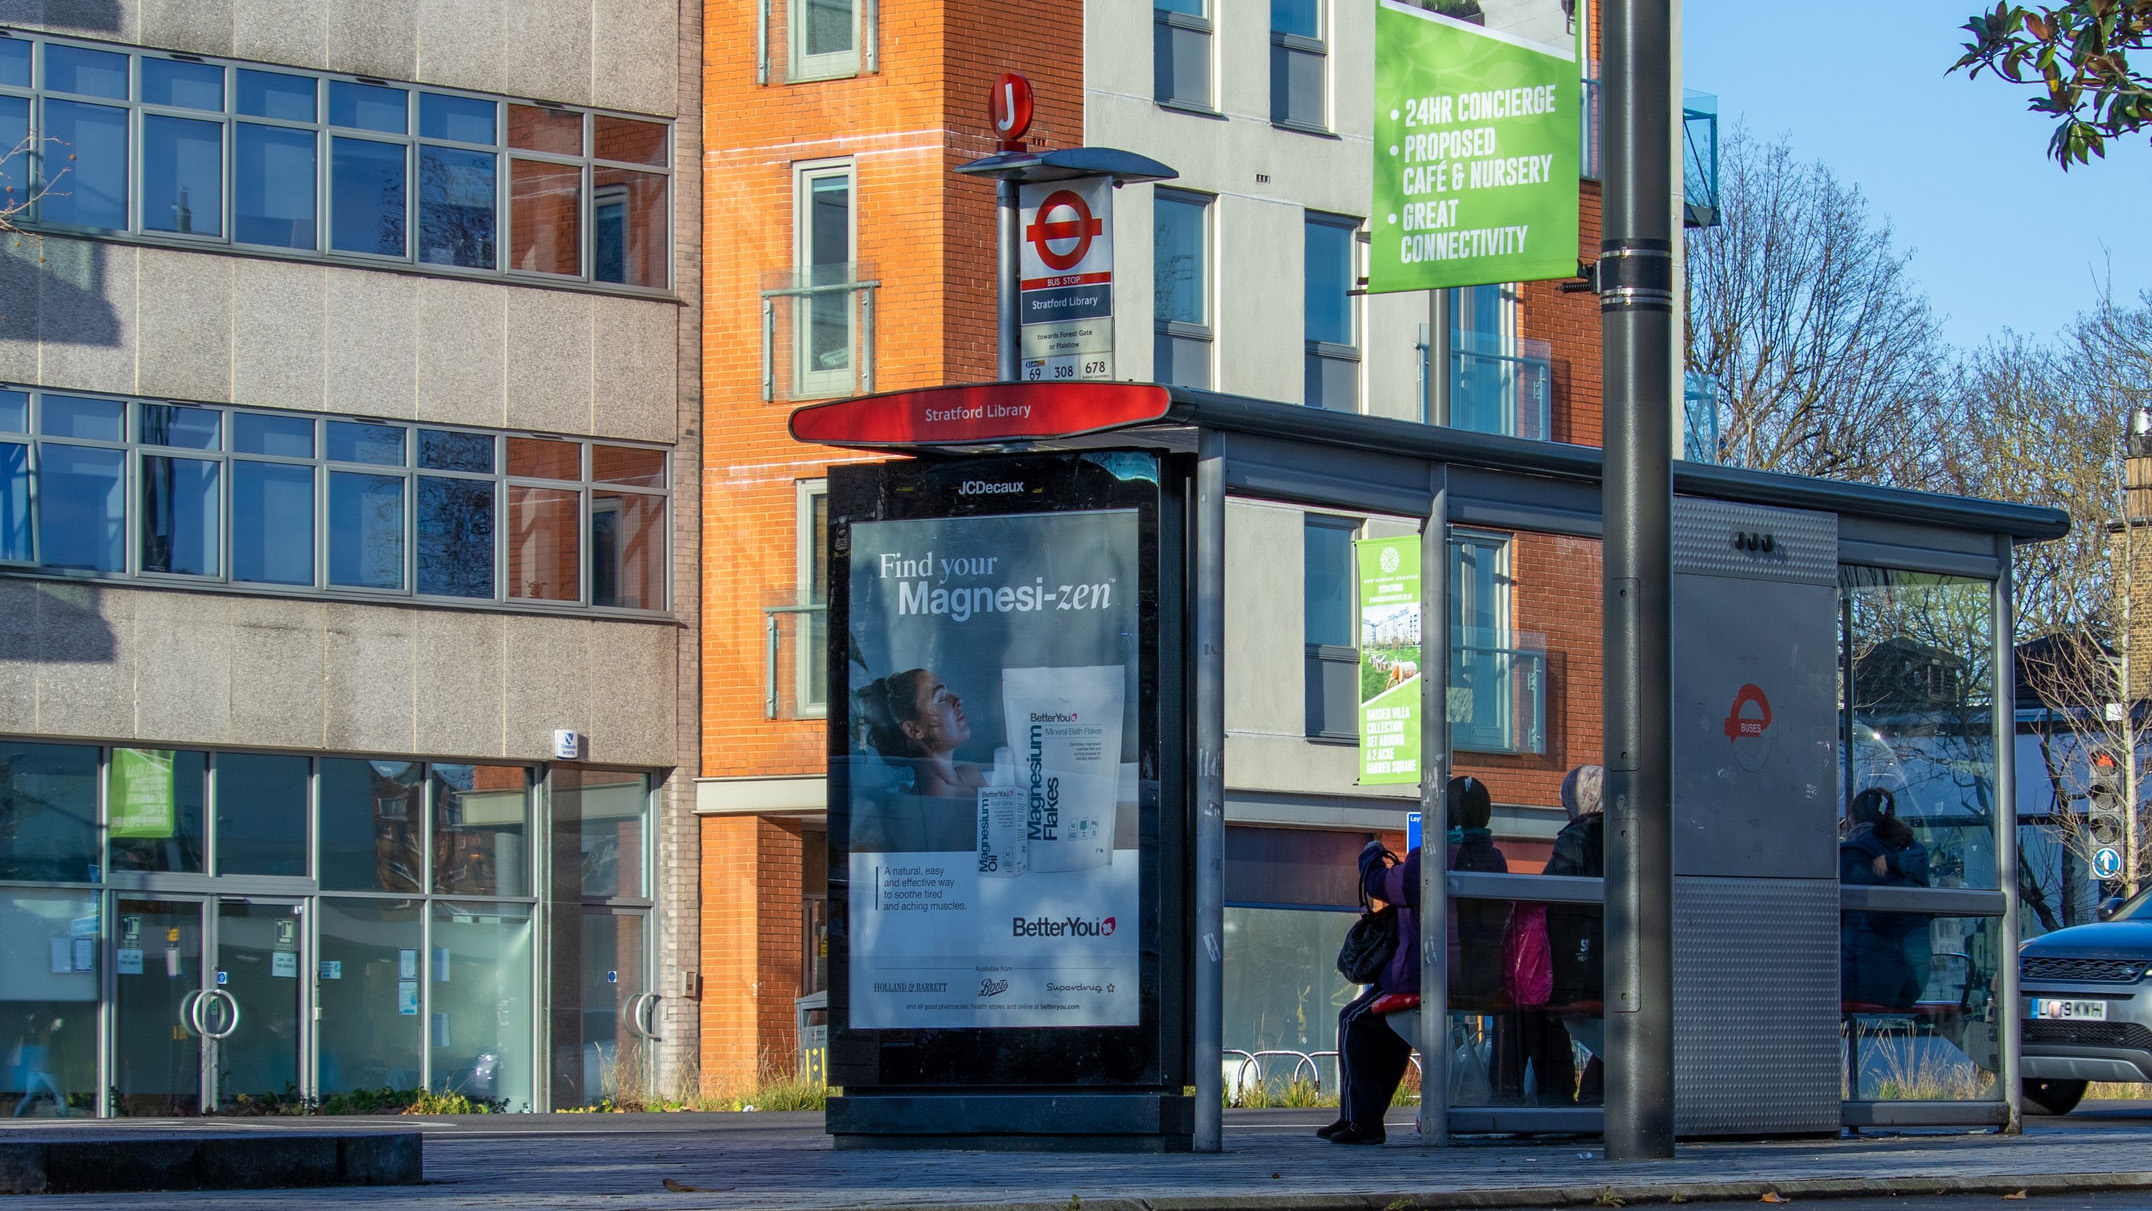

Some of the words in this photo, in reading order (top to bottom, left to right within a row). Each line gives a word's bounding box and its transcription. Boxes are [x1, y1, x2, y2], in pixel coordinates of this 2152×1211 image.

[998, 83, 1015, 131] J
[1405, 96, 1453, 127] 24HR
[1457, 85, 1556, 121] CONCIERGE
[1405, 127, 1496, 163] PROPOSED
[1403, 160, 1447, 195] CAFÉ
[1452, 163, 1464, 190] &
[1470, 154, 1553, 189] NURSERY
[1402, 199, 1459, 231] GREAT
[1400, 225, 1528, 264] CONNECTIVITY
[1047, 278, 1060, 287] BUS
[1063, 276, 1081, 285] STOP
[1032, 298, 1068, 310] Stratford
[1069, 296, 1098, 307] Library
[1037, 332, 1059, 340] towards
[1060, 330, 1078, 338] Forest
[1056, 341, 1079, 349] Plaistow
[1029, 368, 1041, 380] 69
[1054, 366, 1074, 378] 308
[1085, 361, 1106, 374] 678
[925, 405, 983, 422] Stratford
[987, 404, 1031, 420] Library
[958, 481, 1024, 495] JCDecaux
[879, 551, 933, 579] Find
[939, 555, 999, 585] your
[1030, 713, 1070, 722] BetterYou
[1391, 706, 1410, 719] VILLA
[1069, 727, 1083, 735] Bath
[1367, 720, 1403, 734] COLLECTION
[1740, 723, 1761, 733] BUSES
[1367, 735, 1378, 748] SET
[1367, 749, 1372, 761] A
[1372, 749, 1377, 761] 2
[1378, 747, 1395, 760] ACRE
[1391, 759, 1417, 773] SQUARE
[1027, 725, 1045, 841] Magnesium
[1043, 777, 1059, 841] Flakes
[979, 799, 990, 872] Magnesium
[988, 855, 998, 872] Oil
[884, 867, 891, 875] A
[892, 866, 923, 876] natural,
[925, 868, 944, 877] easy
[884, 878, 899, 887] and
[902, 877, 936, 887] effective
[938, 880, 955, 888] way
[884, 891, 892, 899] to
[894, 890, 922, 899] soothe
[924, 890, 942, 899] tired
[883, 902, 899, 911] and
[901, 901, 928, 912] aching
[930, 901, 967, 911] muscles.
[1013, 917, 1100, 937] BetterYou
[874, 982, 907, 993] HOLLAND
[908, 983, 915, 993] &
[916, 982, 947, 993] BARRETT
[978, 978, 1008, 997] Boots
[1046, 982, 1102, 994] Superdrug
[1040, 1003, 1080, 1011] betteryou.com
